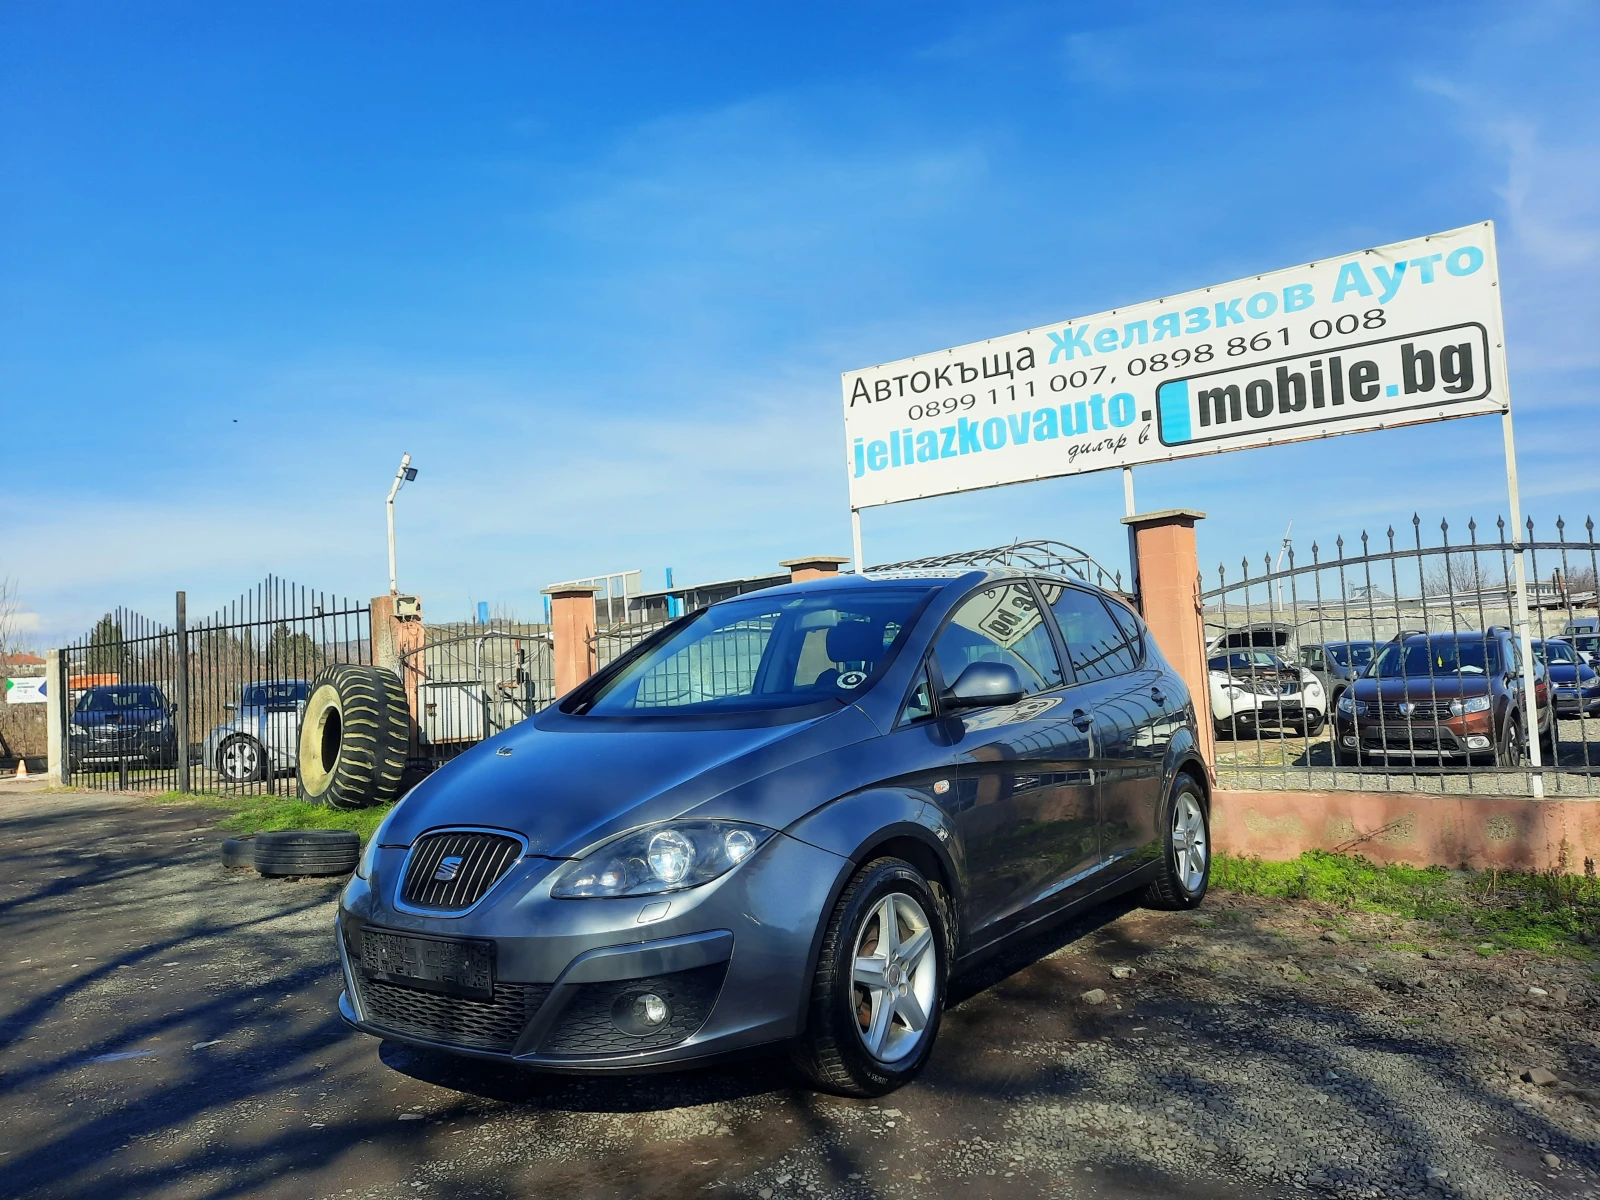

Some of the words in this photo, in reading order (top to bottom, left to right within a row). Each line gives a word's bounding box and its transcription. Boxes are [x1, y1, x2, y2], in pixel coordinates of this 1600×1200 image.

[850, 346, 1036, 408] Автокъща
[1048, 282, 1315, 364] Желязков
[1332, 246, 1484, 305] Ауто
[908, 393, 976, 421] 0899
[988, 381, 1035, 405] 111
[1050, 365, 1117, 393] 007,
[1127, 344, 1215, 377] 0898
[1227, 327, 1290, 357] 861
[1310, 308, 1387, 340] 008
[1198, 342, 1475, 428] mobile.bg
